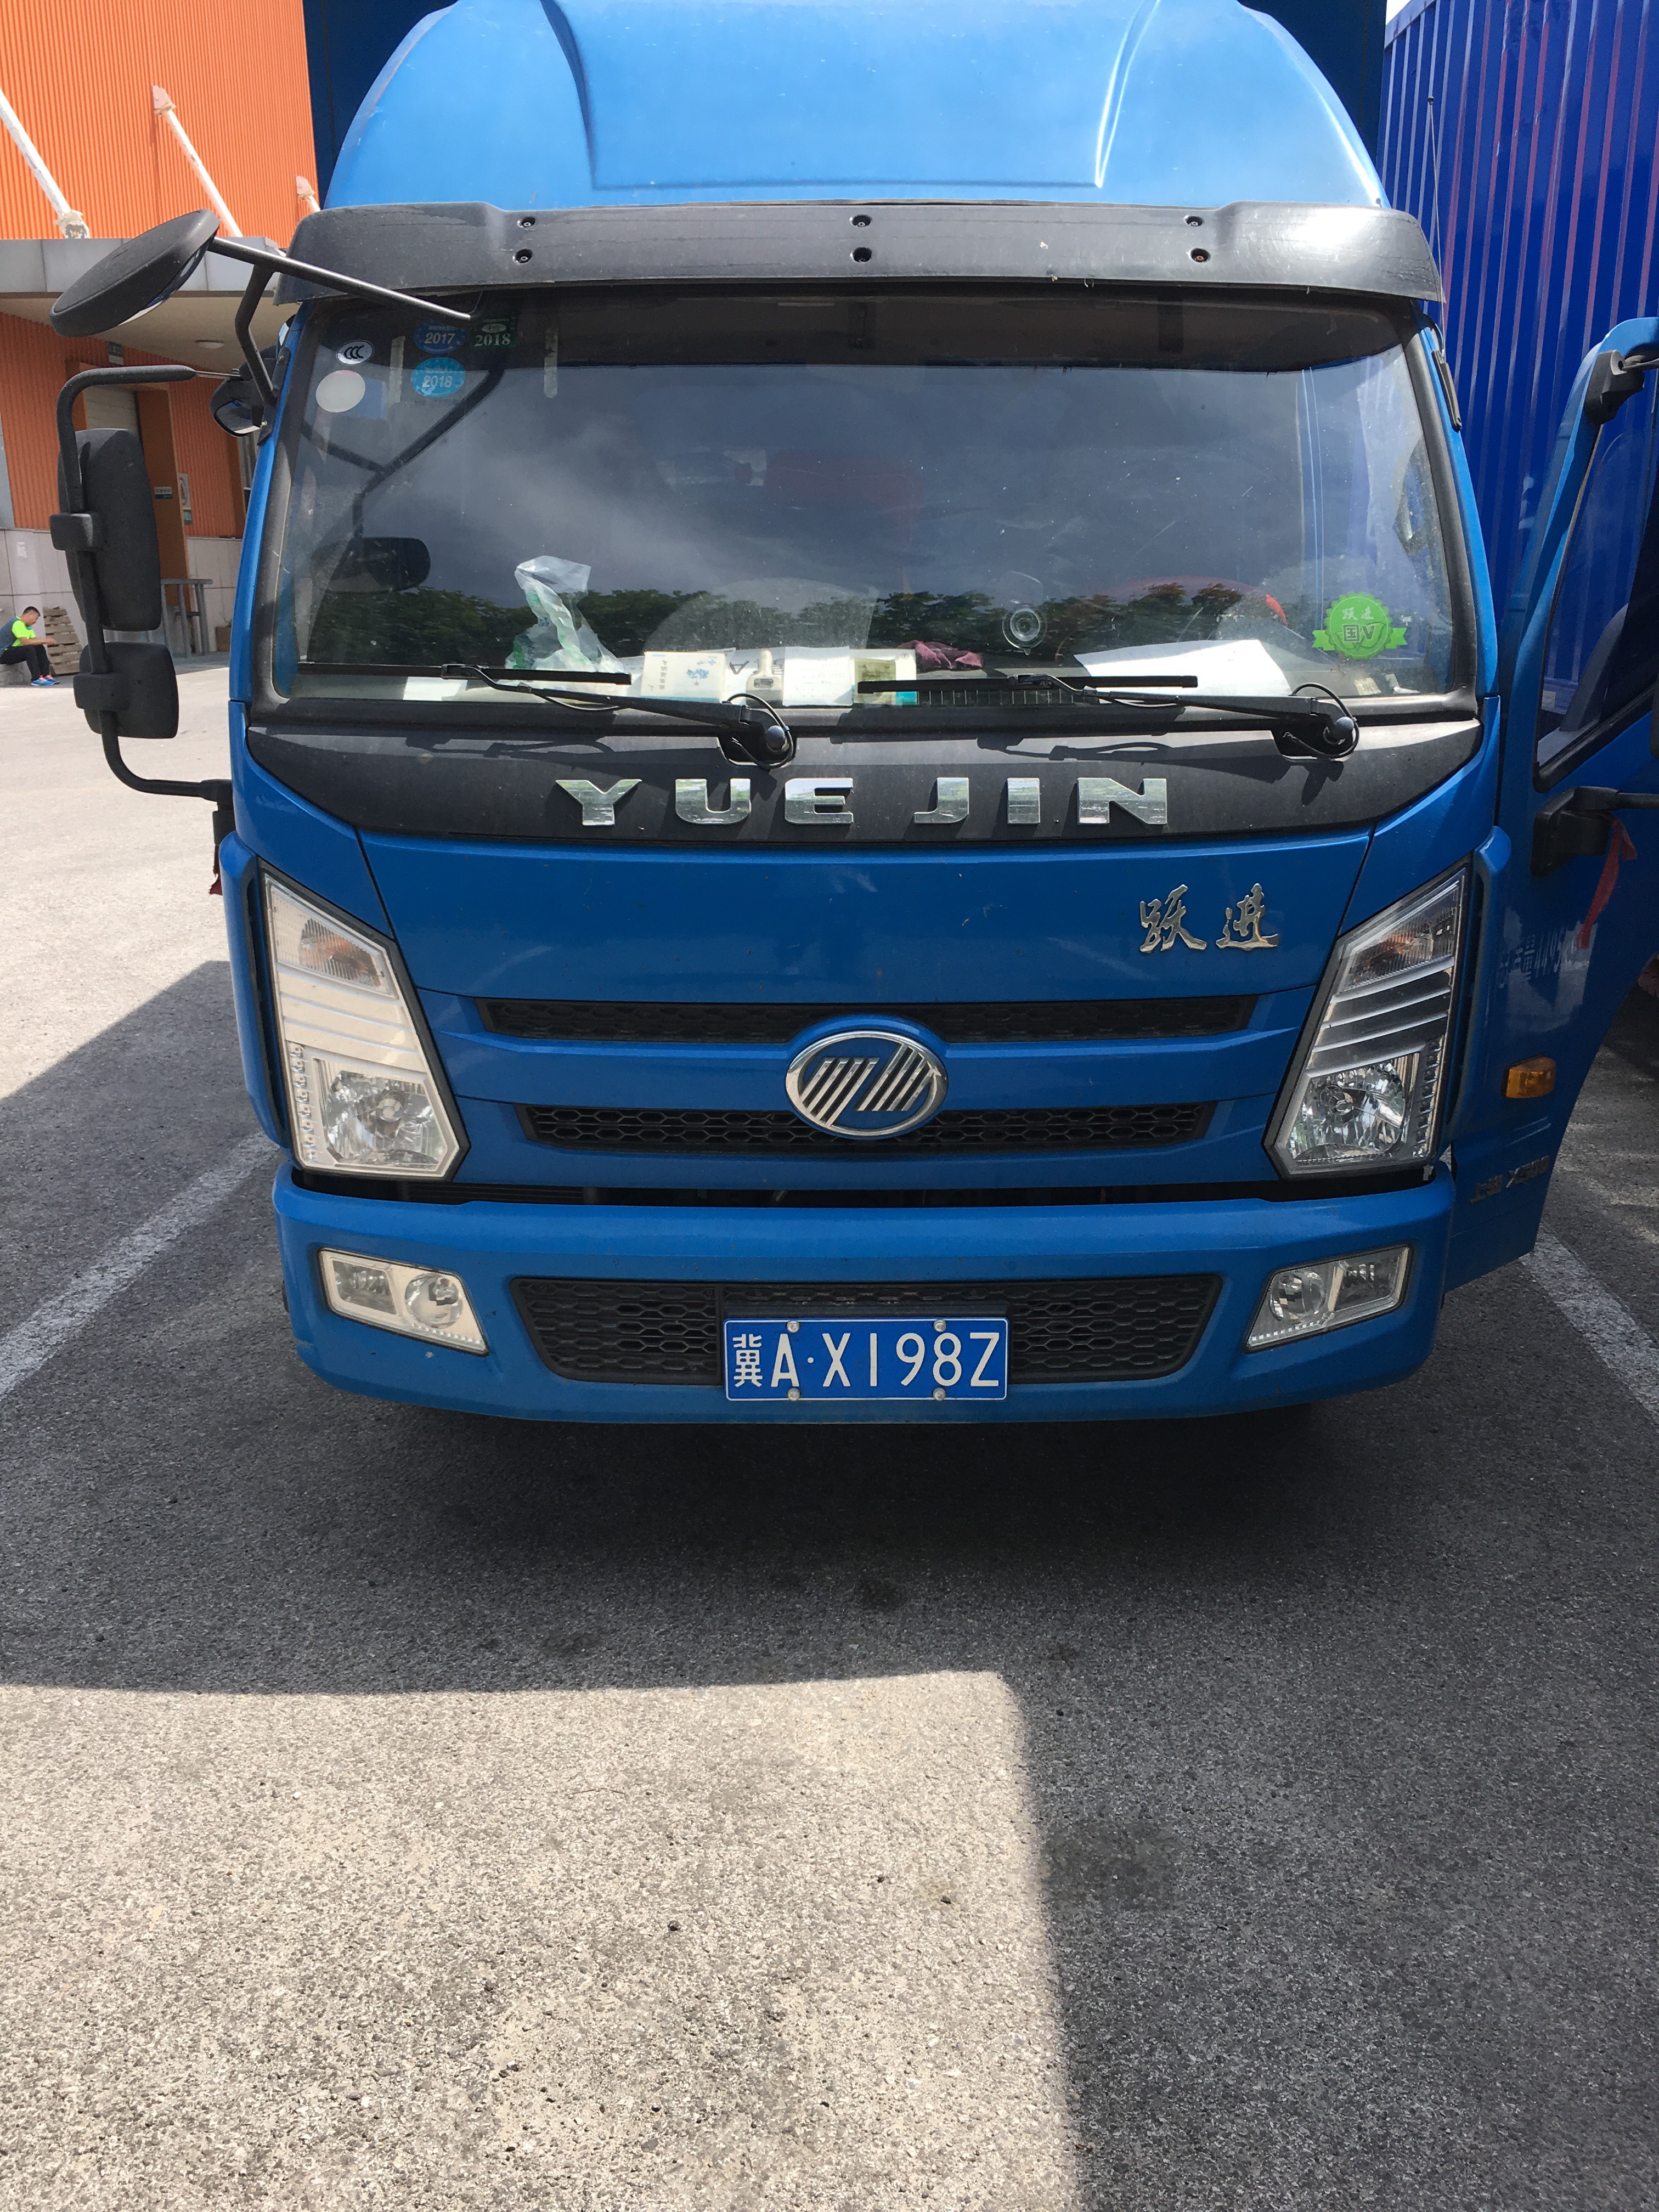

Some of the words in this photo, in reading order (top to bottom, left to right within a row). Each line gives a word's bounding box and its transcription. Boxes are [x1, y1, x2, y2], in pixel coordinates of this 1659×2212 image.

[424, 332, 455, 345] 2017
[474, 333, 511, 347] 2018
[422, 375, 453, 388] 2018
[1139, 883, 1279, 953] 跃进
